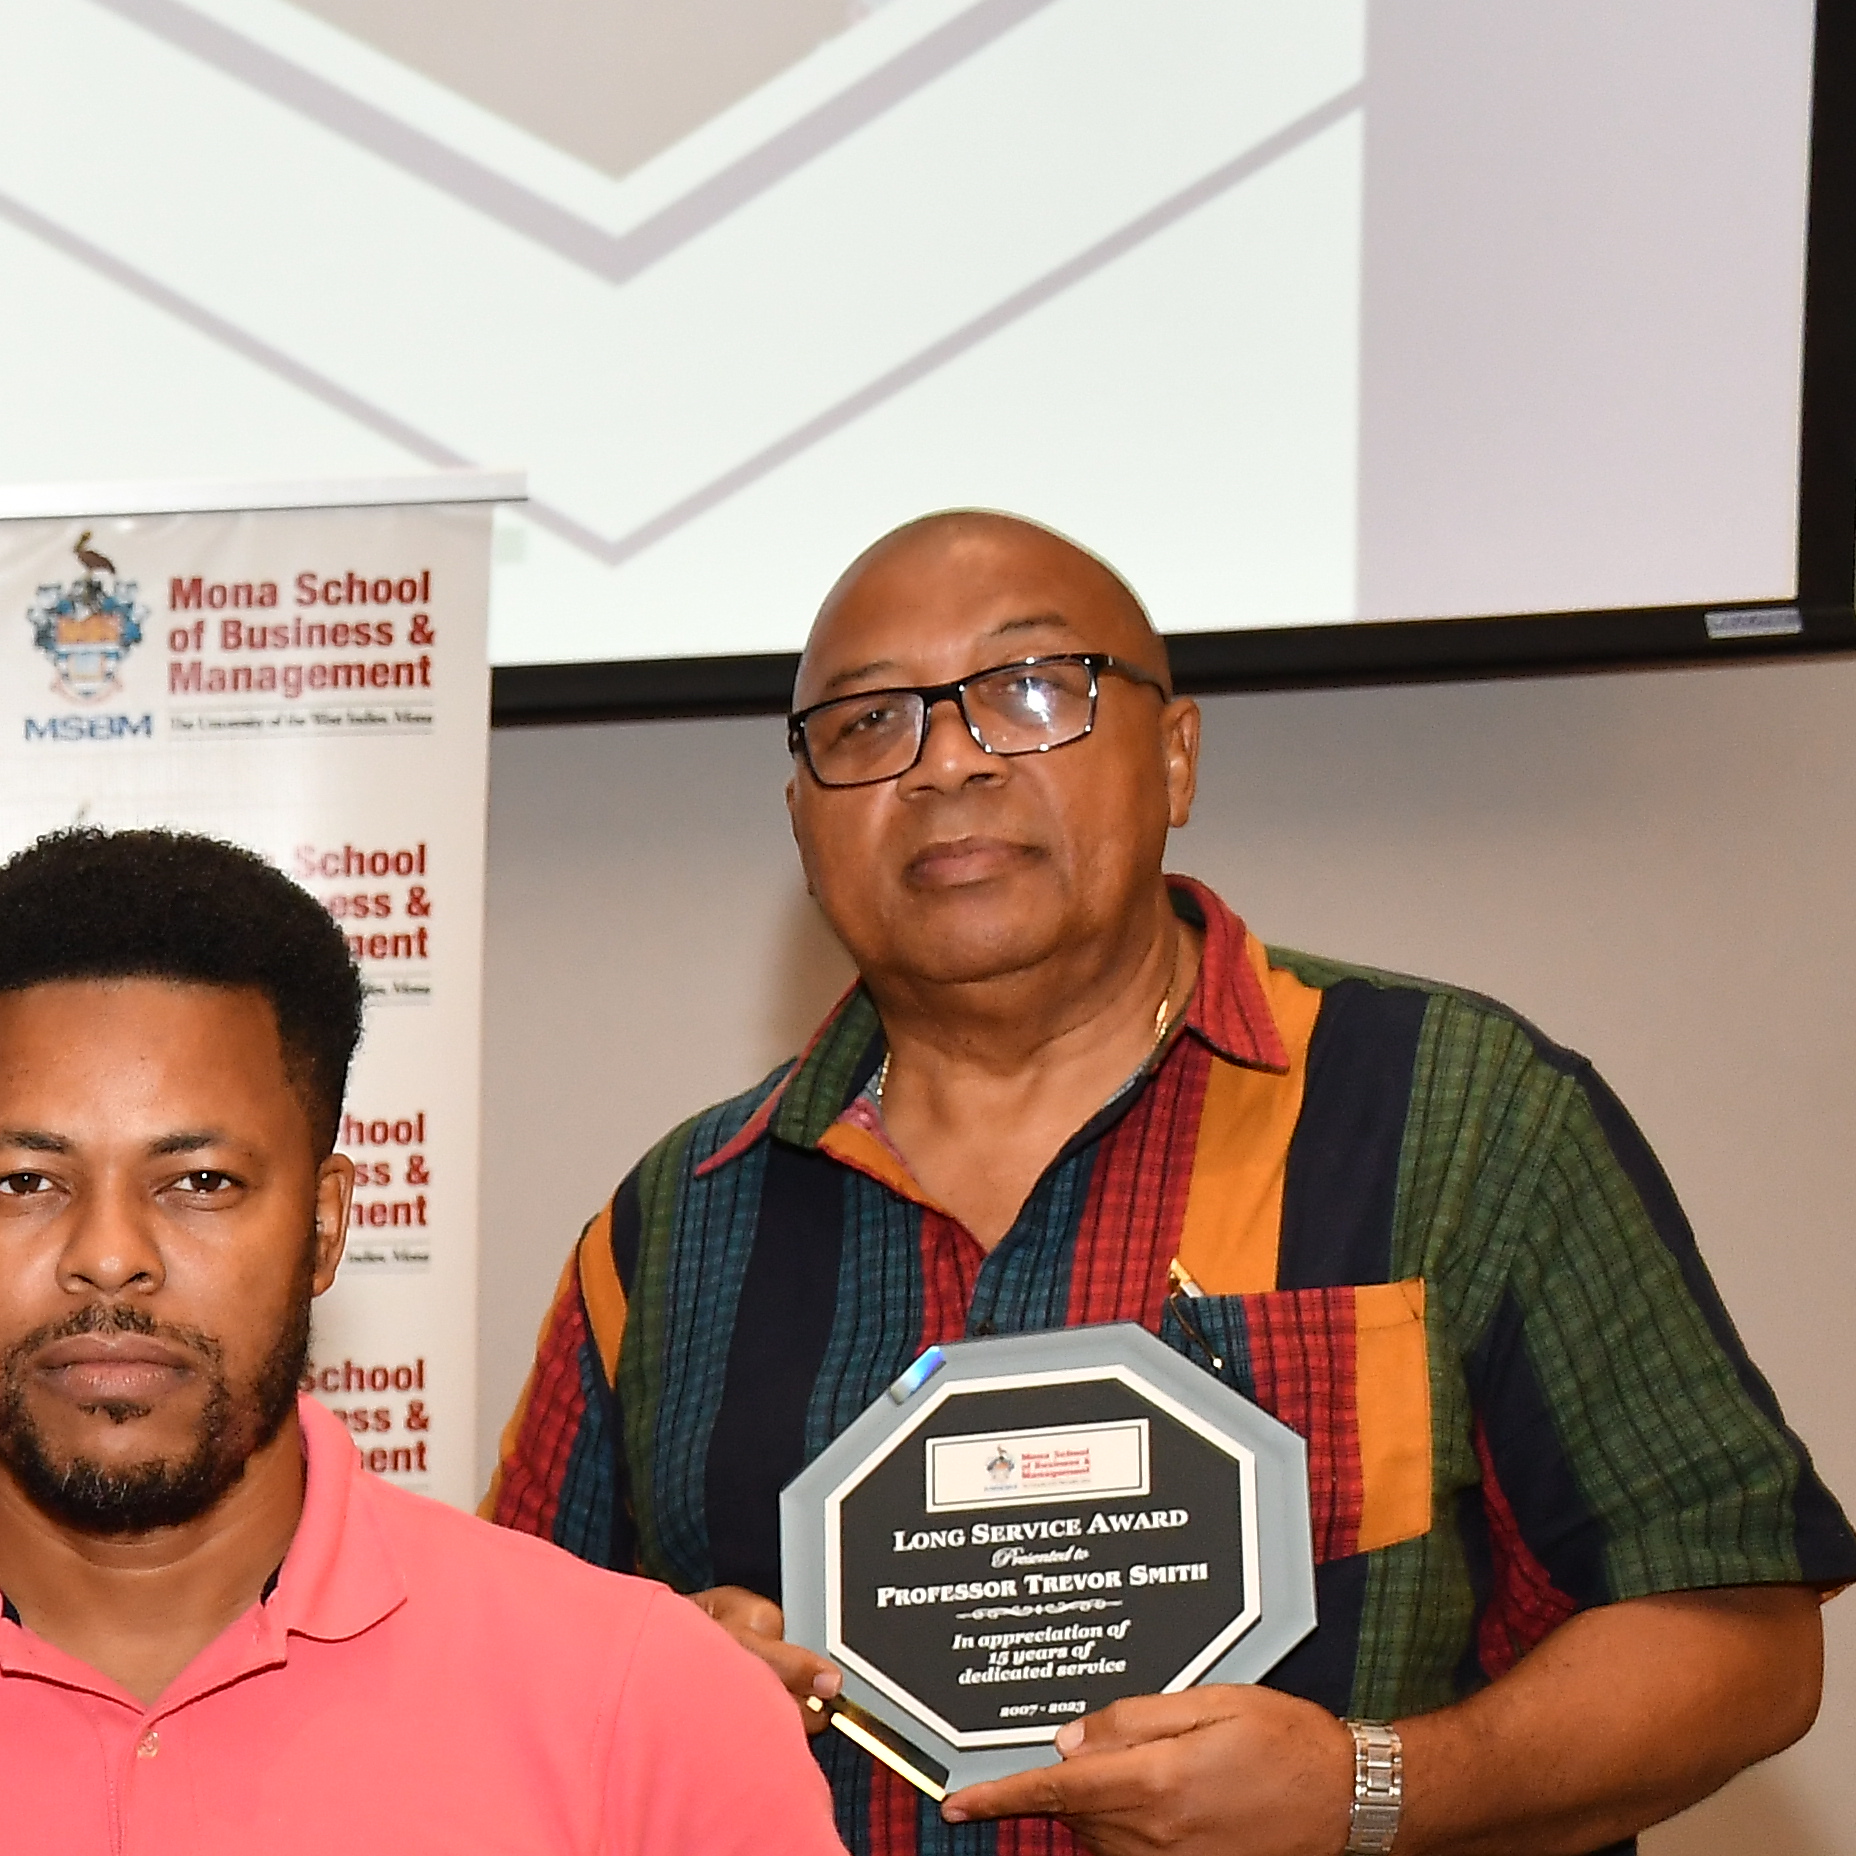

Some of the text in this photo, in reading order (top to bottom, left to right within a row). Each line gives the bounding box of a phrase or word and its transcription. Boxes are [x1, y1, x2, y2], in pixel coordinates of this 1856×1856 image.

[168, 570, 431, 611] Mona School
[169, 613, 435, 652] of Business &
[168, 654, 432, 699] Management
[25, 714, 153, 741] MSBM
[407, 886, 430, 917] &
[406, 1155, 430, 1186] &
[406, 1400, 429, 1431] &
[952, 1619, 1131, 1650] In appreciation of
[988, 1641, 1096, 1666] 15 years of
[958, 1657, 1127, 1685] dedicated service
